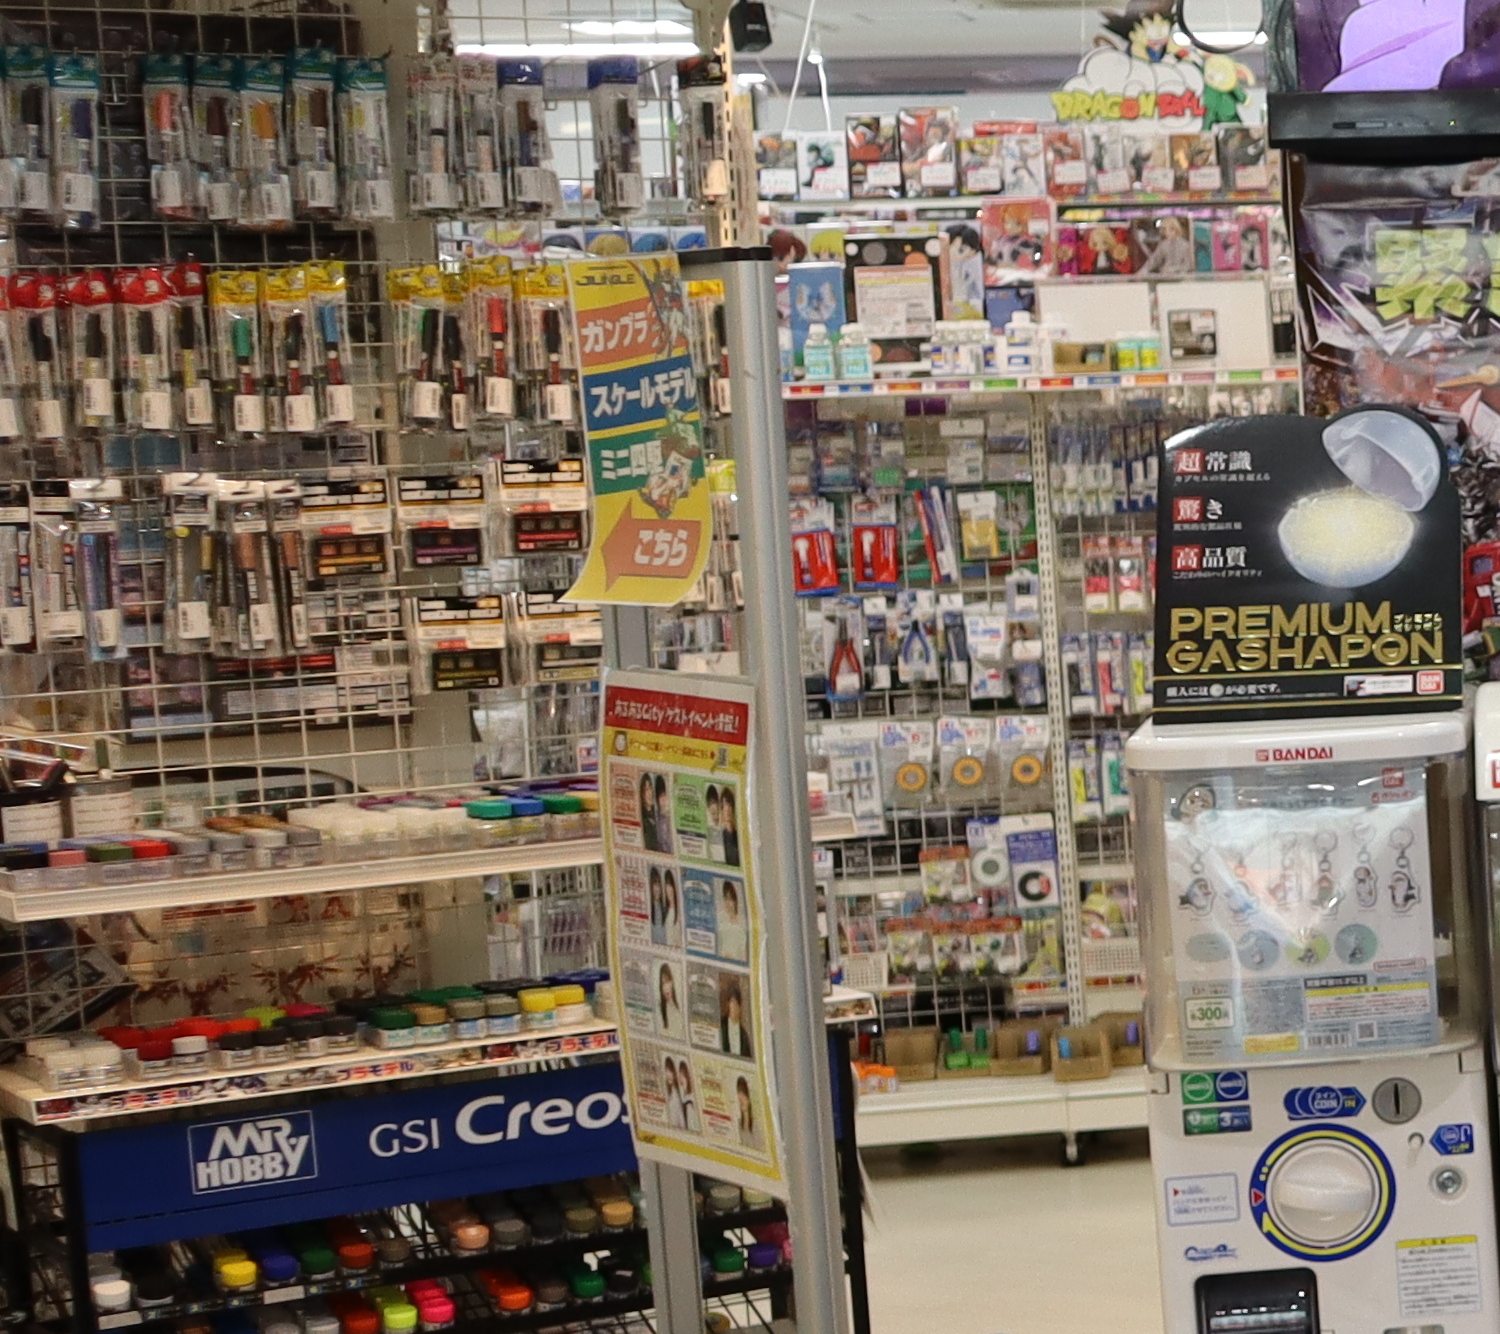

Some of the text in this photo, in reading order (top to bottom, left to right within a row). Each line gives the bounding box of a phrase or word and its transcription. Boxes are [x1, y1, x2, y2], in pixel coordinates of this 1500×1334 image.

[1051, 91, 1155, 122] DRAGON
[580, 310, 649, 354] ガンプラ
[590, 366, 696, 418] スケールモデル
[1174, 449, 1252, 473] 超常識
[1173, 497, 1224, 521] 驚き
[633, 529, 689, 567] こちら
[1172, 545, 1248, 571] 高品質
[1170, 601, 1392, 641] PREMIUM
[1166, 633, 1444, 674] GASHAPON
[1273, 747, 1334, 761] BANDAI
[1314, 1099, 1338, 1110] COIN
[369, 1122, 441, 1159] GSI
[197, 1129, 310, 1190] HOBBY
